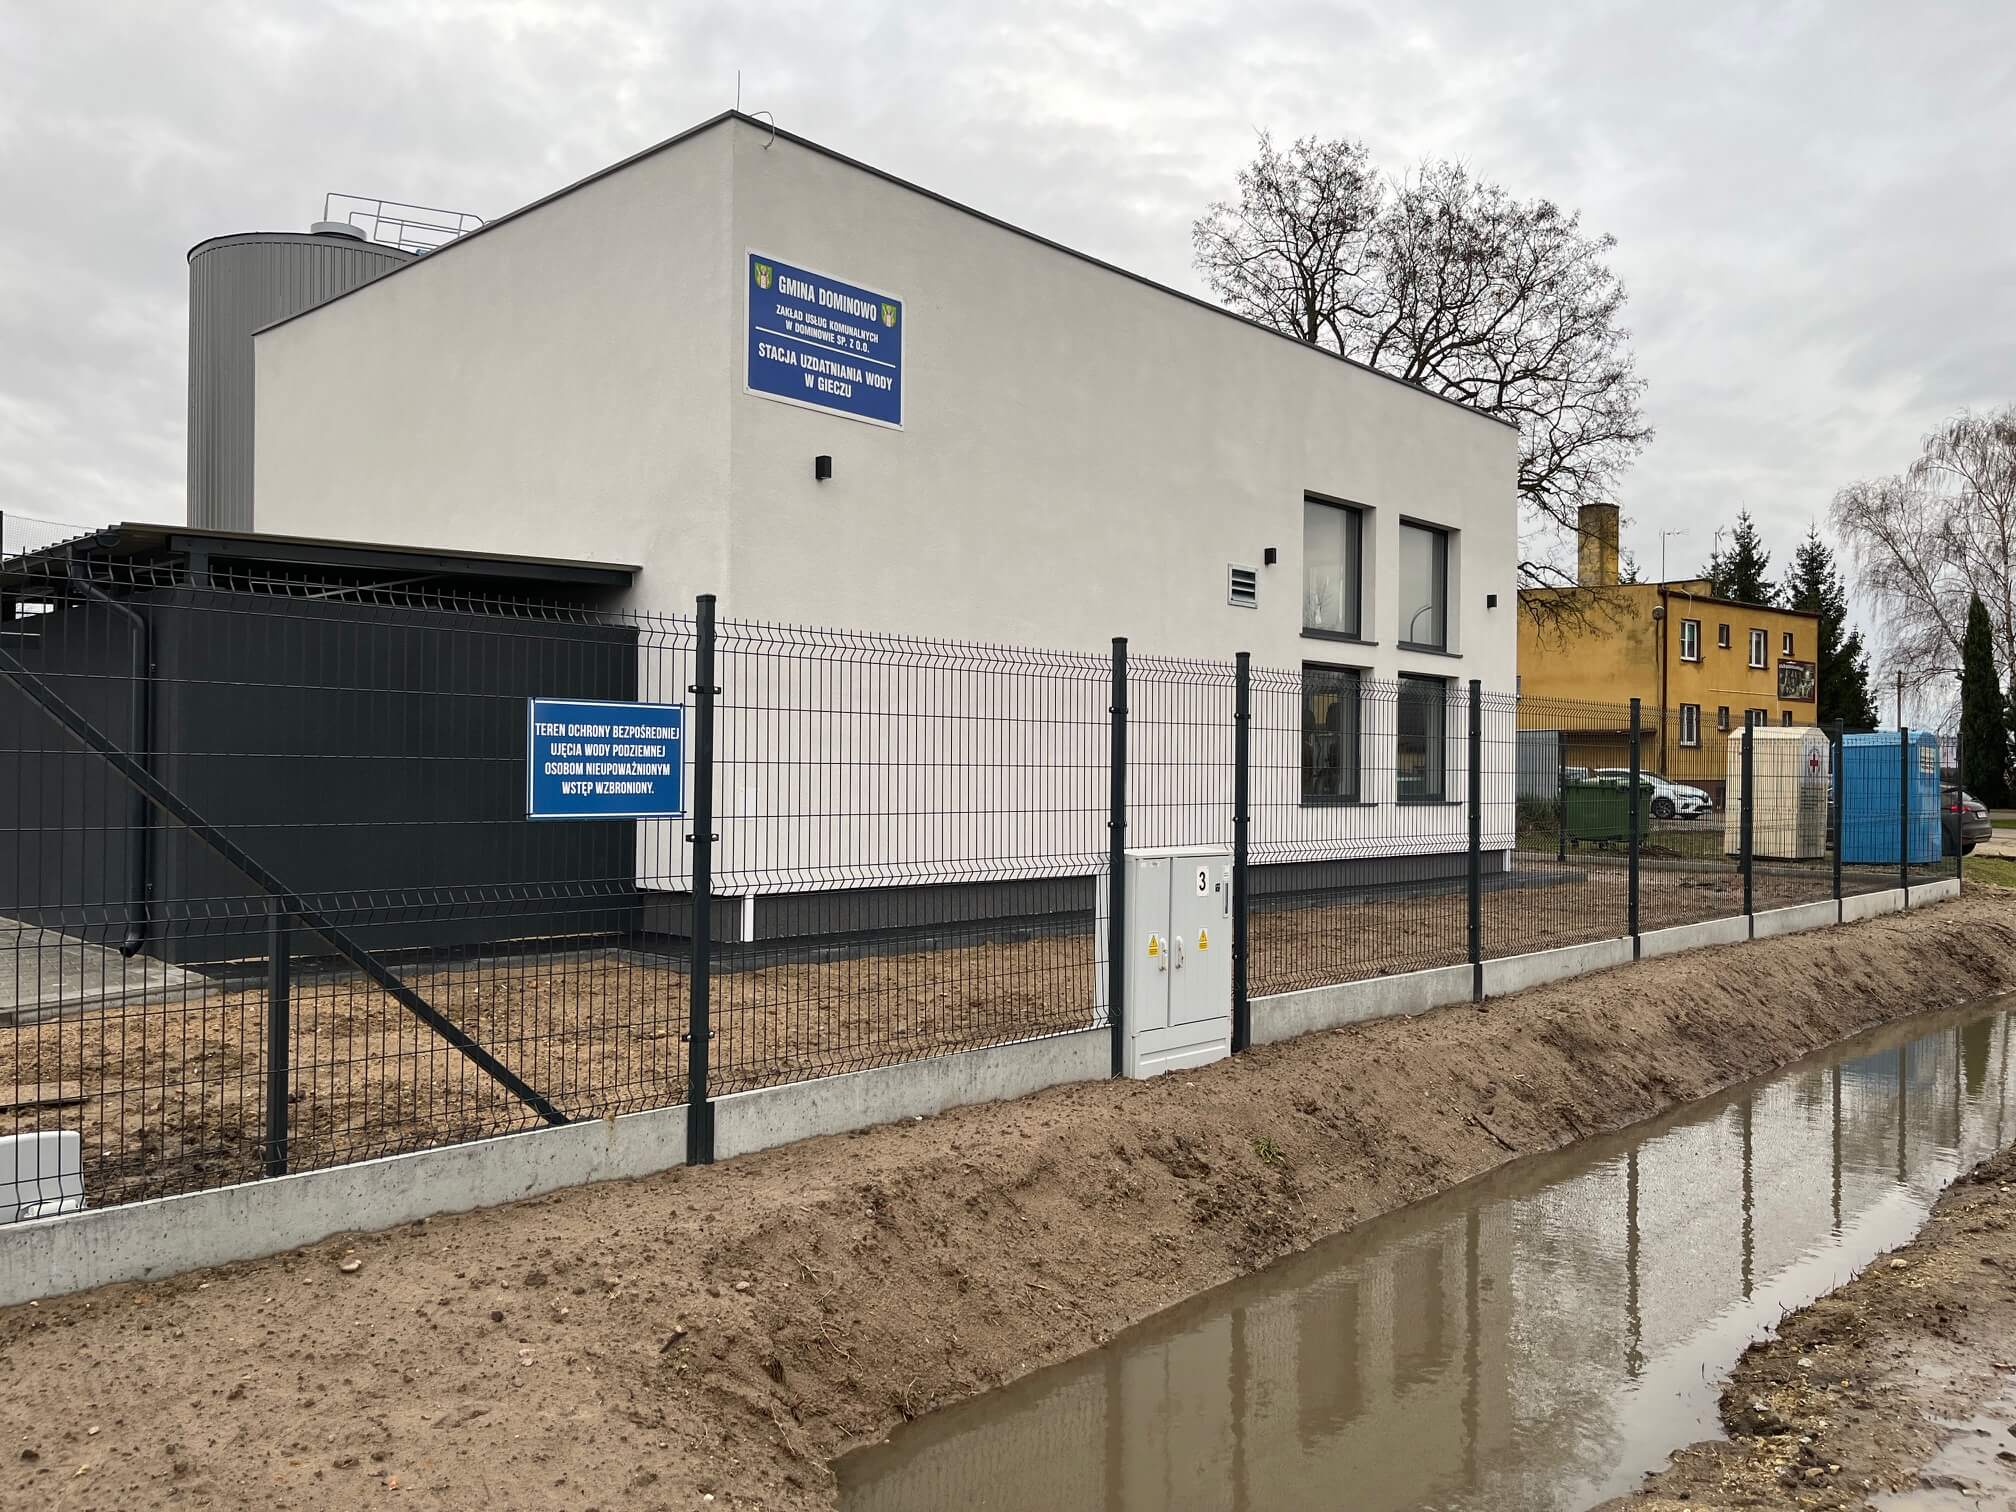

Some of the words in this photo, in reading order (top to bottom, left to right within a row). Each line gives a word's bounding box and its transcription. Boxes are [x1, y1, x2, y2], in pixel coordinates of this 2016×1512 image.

[779, 275, 815, 303] GMINA
[819, 288, 877, 321] DOMINOWO
[776, 305, 803, 321] ZAKŁAD
[805, 313, 827, 328] USŁUG
[829, 320, 878, 343] KOMUNALNYCH
[785, 320, 792, 330] W
[795, 322, 835, 343] DOMINOWIE
[837, 334, 847, 347] SP.
[850, 339, 854, 348] Z
[758, 342, 797, 365] STACJA
[800, 354, 862, 383] UZDATNIANIA
[865, 371, 893, 391] WODY
[805, 374, 815, 388] W
[818, 377, 851, 398] GIECZU
[535, 723, 565, 736] TEREN
[568, 724, 611, 737] OCHRONY
[613, 725, 679, 739] BEZPOŚREDNIEJ
[551, 743, 582, 758] UJĘCIA
[585, 744, 610, 756] WODY
[613, 744, 665, 757] PODZIEMNEJ
[545, 762, 584, 775] OSOBOM
[586, 761, 670, 776] NIEUPOWAŻNIONYM
[562, 782, 593, 796] WSTĘP
[595, 782, 654, 794] WZBRONIONY.
[1199, 871, 1206, 891] 3
